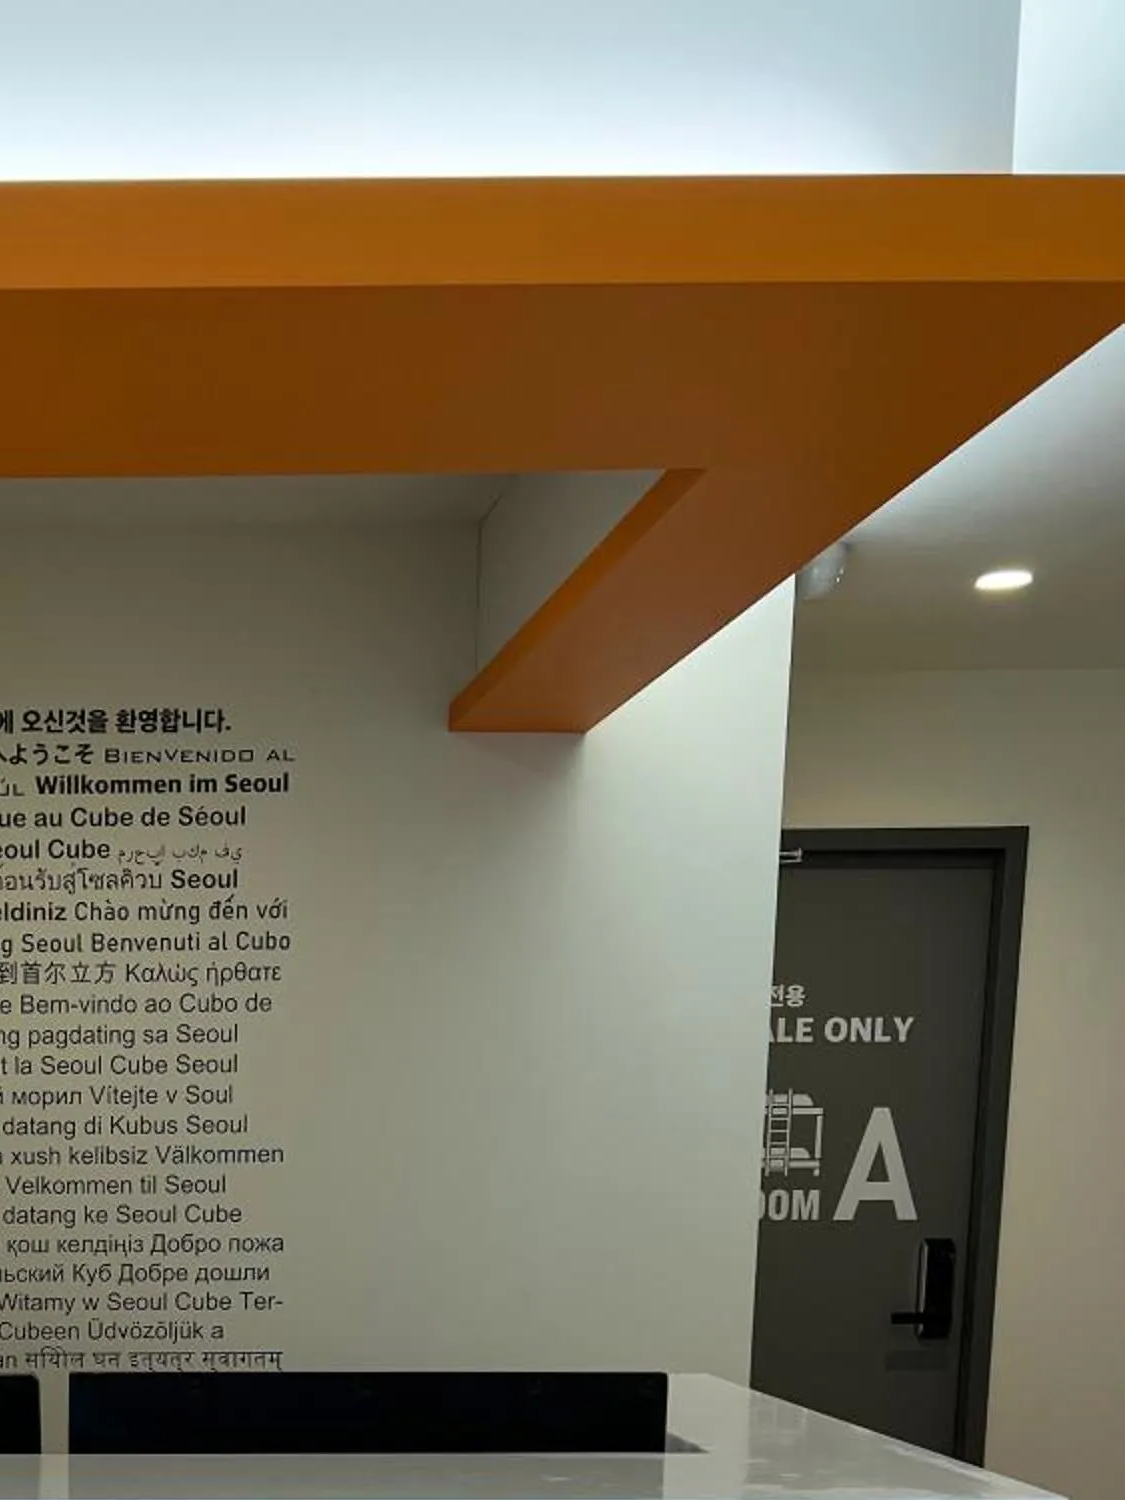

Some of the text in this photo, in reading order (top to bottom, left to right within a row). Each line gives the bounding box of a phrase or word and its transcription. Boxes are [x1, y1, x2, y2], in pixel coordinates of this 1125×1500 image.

[21, 709, 109, 734] 오신것을
[115, 709, 231, 734] 환영합니다.
[35, 774, 181, 795] Willkommen
[189, 774, 217, 793] im
[225, 772, 289, 793] Seoul
[34, 812, 62, 828] au
[71, 806, 134, 827] Cube
[141, 806, 170, 827] de
[179, 805, 245, 826] Séoul
[47, 839, 110, 859] Cube
[171, 868, 239, 889] Seoul
[75, 898, 129, 921] Chào
[209, 896, 248, 920] đến
[256, 897, 288, 919] với
[21, 933, 83, 953] Seoul
[91, 932, 200, 953] Benvenuti
[208, 931, 228, 951] al
[236, 930, 291, 951] Cubo
[21, 994, 137, 1015] Bem-vindo
[145, 998, 171, 1014] ao
[179, 992, 238, 1013] Cubo
[245, 992, 272, 1013] de
[29, 1024, 135, 1050] pagdating
[143, 1029, 168, 1045] sa
[176, 1024, 238, 1043] Seoul
[769, 1017, 914, 1043] LE ONLY
[15, 1056, 32, 1075] la
[41, 1055, 101, 1075] Seoul
[110, 1054, 168, 1075] Cube
[176, 1054, 238, 1075] Seoul
[11, 1090, 82, 1110] морил
[166, 1089, 177, 1104] v
[185, 1084, 233, 1104] Soul
[2, 1116, 76, 1140] datang
[84, 1116, 102, 1135] di
[110, 1115, 178, 1135] Kubus
[186, 1115, 247, 1135] Seoul
[11, 1146, 61, 1166] xush
[69, 1145, 148, 1165] kelibsiz
[155, 1145, 283, 1165] Välkommen
[832, 1107, 918, 1221] A
[5, 1176, 132, 1195] Velkommen
[140, 1175, 157, 1194] til
[165, 1174, 226, 1195] Seoul
[2, 1206, 75, 1229] datang
[84, 1205, 108, 1224] ke
[116, 1204, 177, 1224] Seoul
[185, 1203, 242, 1224] Cube
[150, 1233, 221, 1257] Добро
[229, 1237, 284, 1253] пожа
[73, 1263, 112, 1287] Куб
[117, 1263, 188, 1287] Добре
[195, 1267, 269, 1285] дошли
[82, 1297, 99, 1311] w
[107, 1292, 167, 1311] Seoul
[175, 1291, 231, 1311] Cube
[239, 1291, 283, 1311] Ter-
[210, 1325, 224, 1339] a
